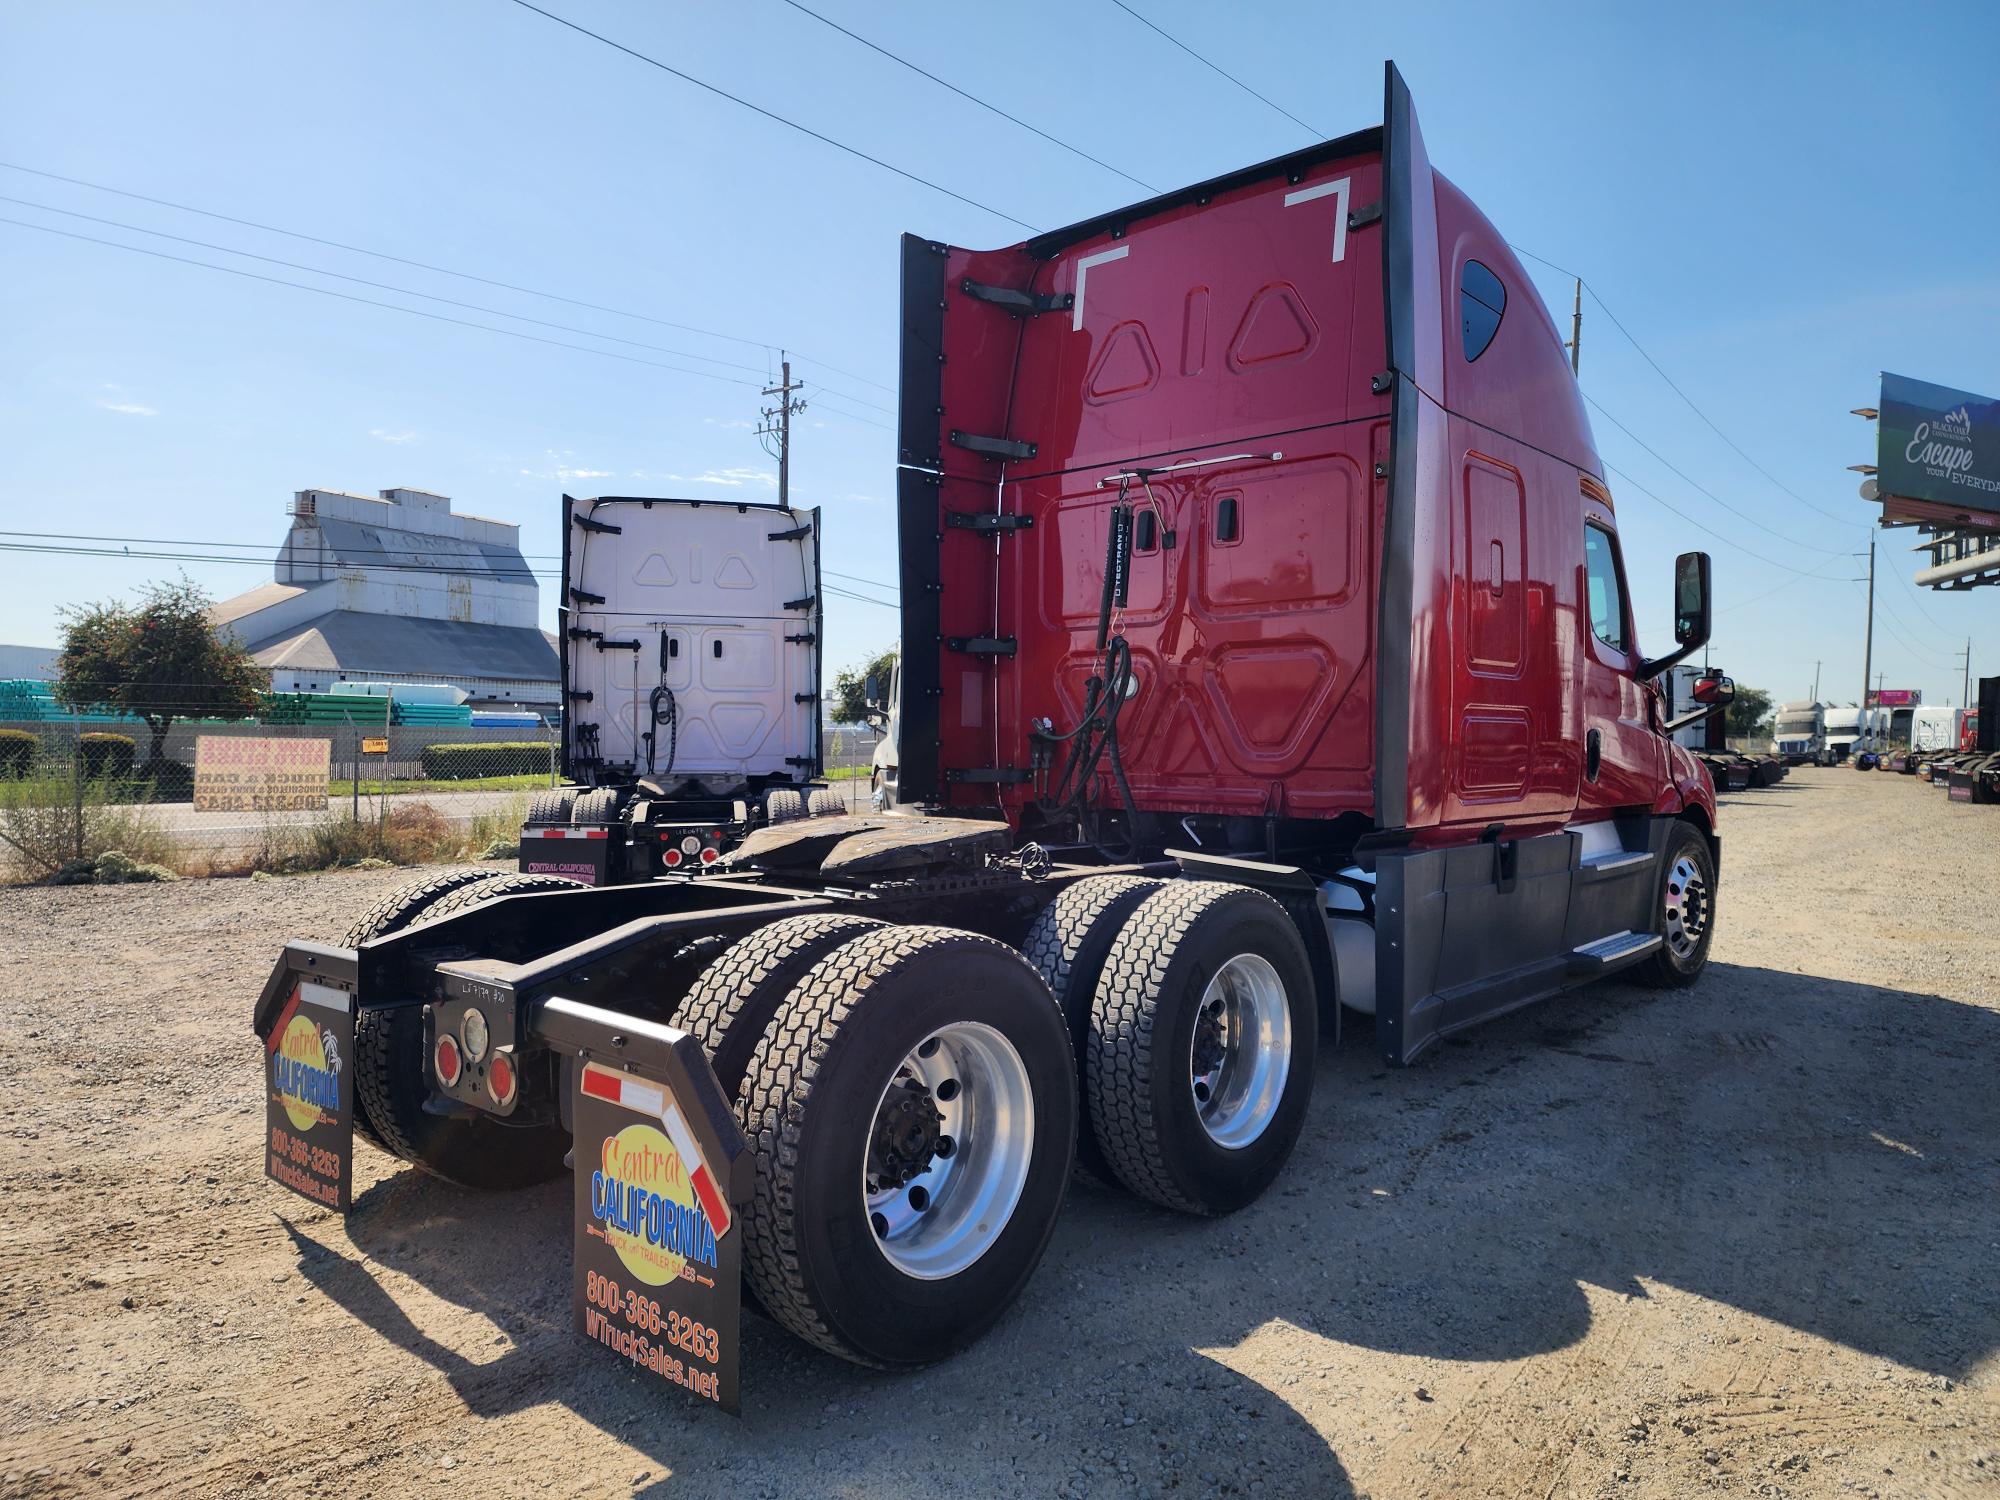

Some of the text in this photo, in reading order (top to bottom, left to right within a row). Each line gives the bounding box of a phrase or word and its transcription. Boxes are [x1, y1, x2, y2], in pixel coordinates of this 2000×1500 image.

[1906, 422, 1974, 479] Escape
[1926, 467, 1945, 478] YOUR
[1115, 534, 1123, 588] TECTRAN
[528, 862, 596, 875] CENTRAL CALIFORNIA
[274, 1052, 340, 1111] CALIFORNIA
[272, 1126, 340, 1180] 800-366-3263
[602, 1136, 683, 1189] Central
[271, 1154, 339, 1207] WTruckSales.net
[591, 1169, 718, 1269] CALIFORNIA
[604, 1229, 628, 1250] TRUCK
[640, 1246, 670, 1272] TRAILER
[671, 1259, 696, 1283] SALES
[586, 1270, 720, 1364] 800-366-3263
[585, 1307, 720, 1402] WTruckSales.net
